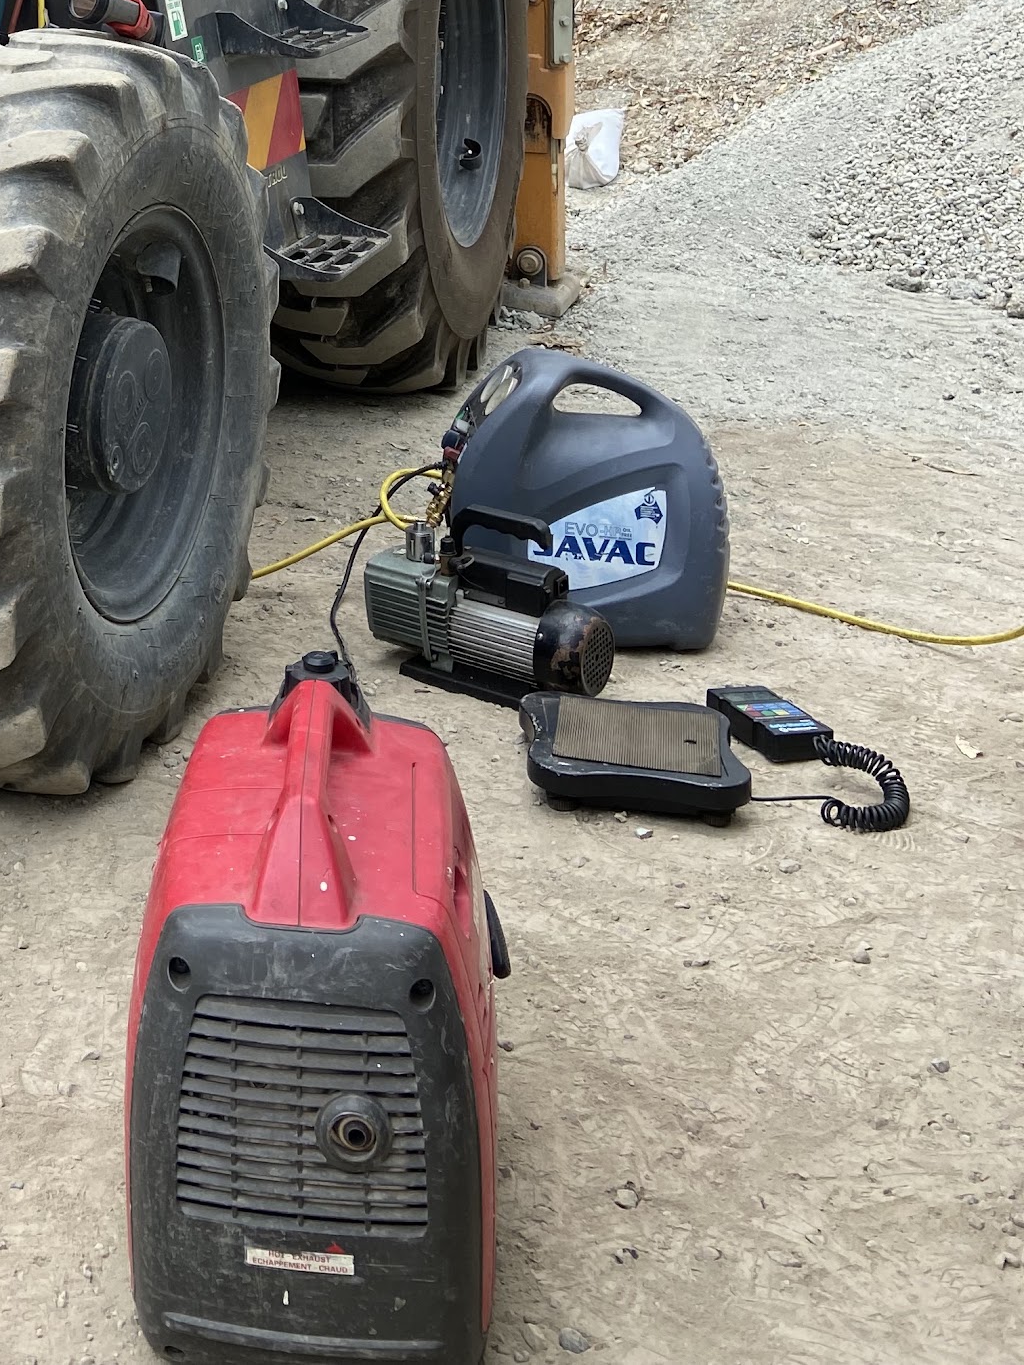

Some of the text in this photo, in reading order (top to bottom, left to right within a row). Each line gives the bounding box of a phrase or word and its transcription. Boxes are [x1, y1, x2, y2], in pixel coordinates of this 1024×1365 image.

[268, 1250, 285, 1258] HOT
[292, 1255, 331, 1263] EXHAUST
[252, 1257, 348, 1274] ECHAPPEMENT CHAUD
